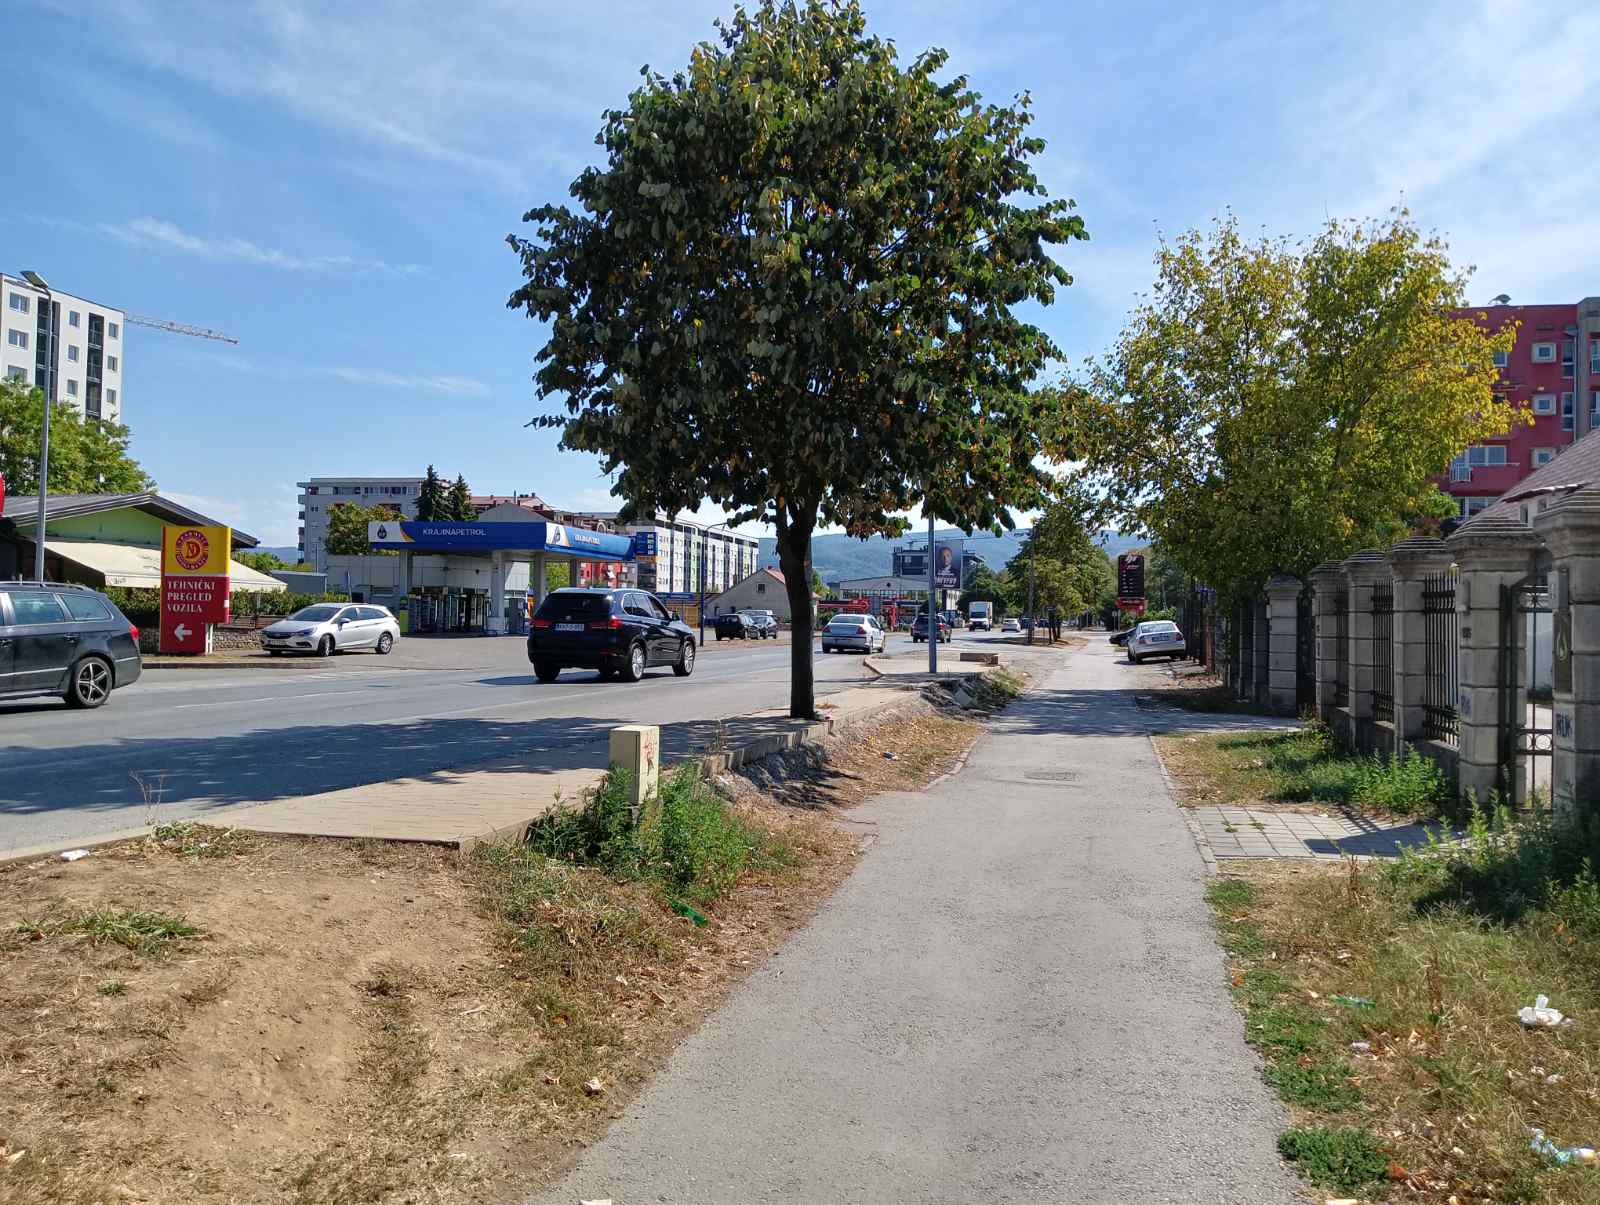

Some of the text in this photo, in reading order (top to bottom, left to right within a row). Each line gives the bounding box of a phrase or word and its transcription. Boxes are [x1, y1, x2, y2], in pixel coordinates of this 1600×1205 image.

[422, 528, 486, 536] KRAJINAPETROL
[168, 579, 215, 590] TEHNIČKI
[167, 592, 212, 602] PREGLED
[167, 603, 203, 613] VOZILA
